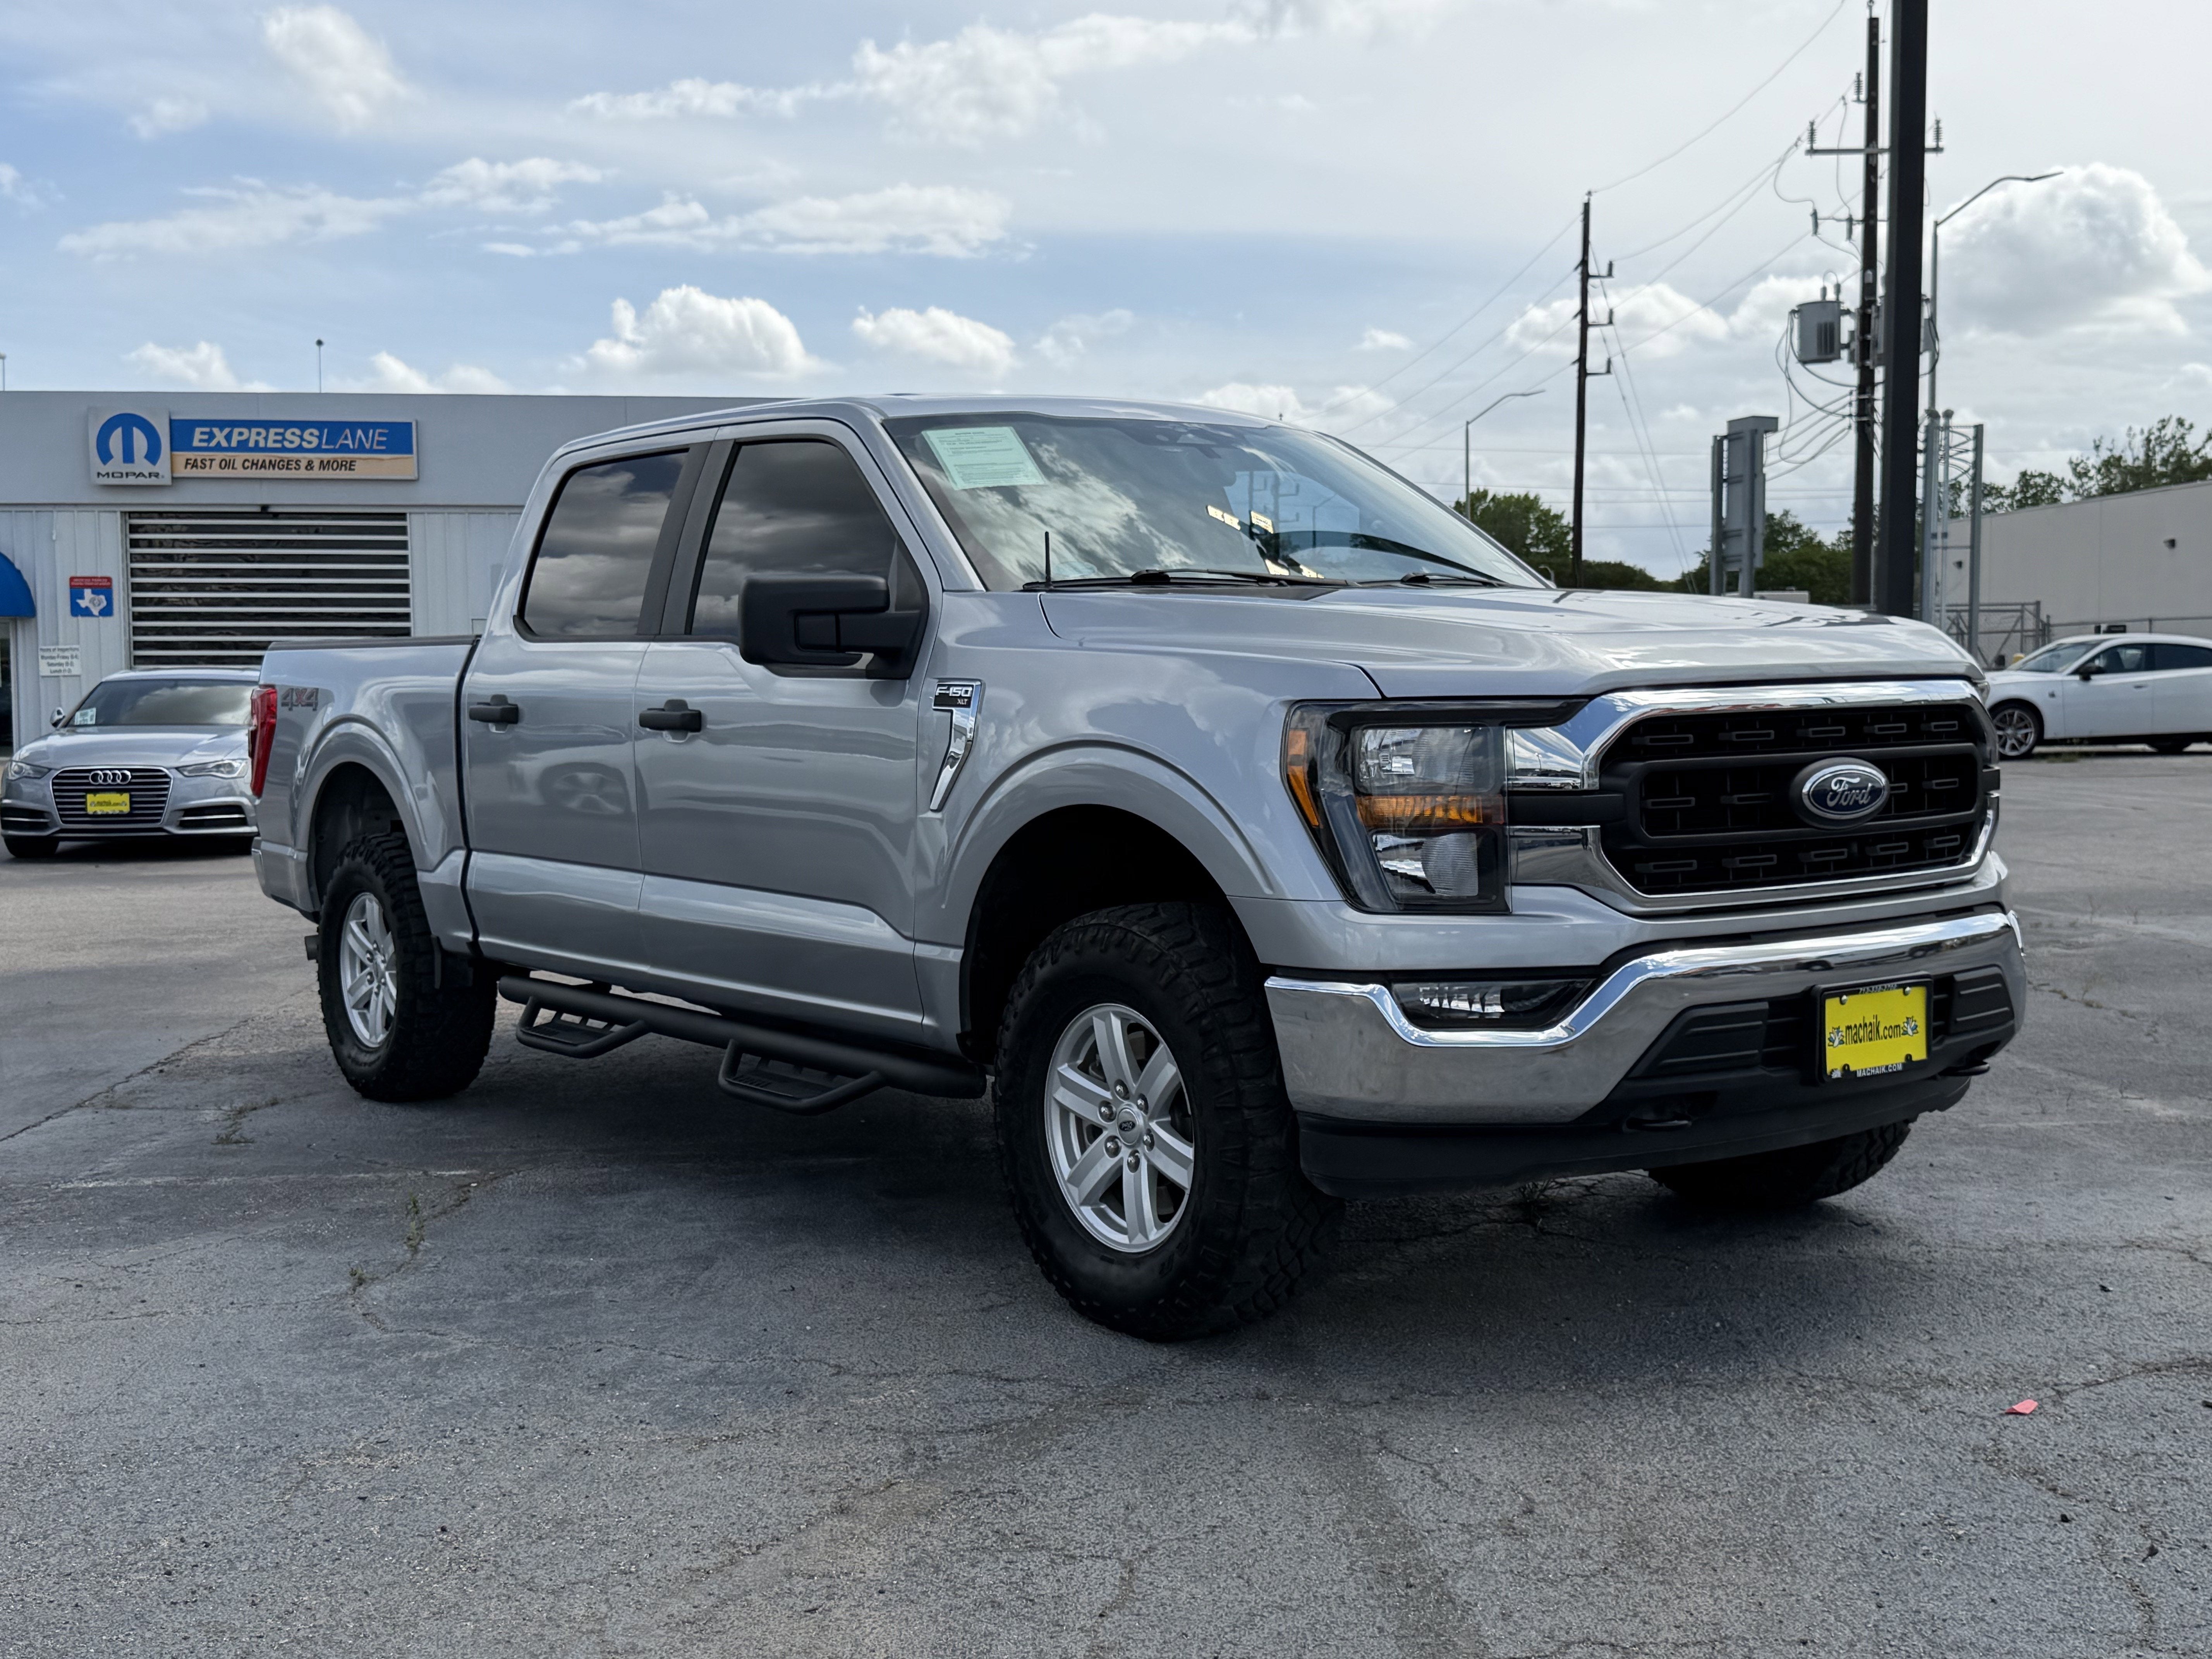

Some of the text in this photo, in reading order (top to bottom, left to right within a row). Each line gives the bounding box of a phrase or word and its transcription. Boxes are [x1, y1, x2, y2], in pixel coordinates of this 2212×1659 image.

[184, 458, 357, 471] FAST OIL CHANGES & MORE
[935, 686, 973, 697] F-150
[1826, 776, 1873, 807] Ford
[1845, 1014, 1901, 1045] machaik.com
[1856, 1063, 1903, 1078] MACHAIK.COM
